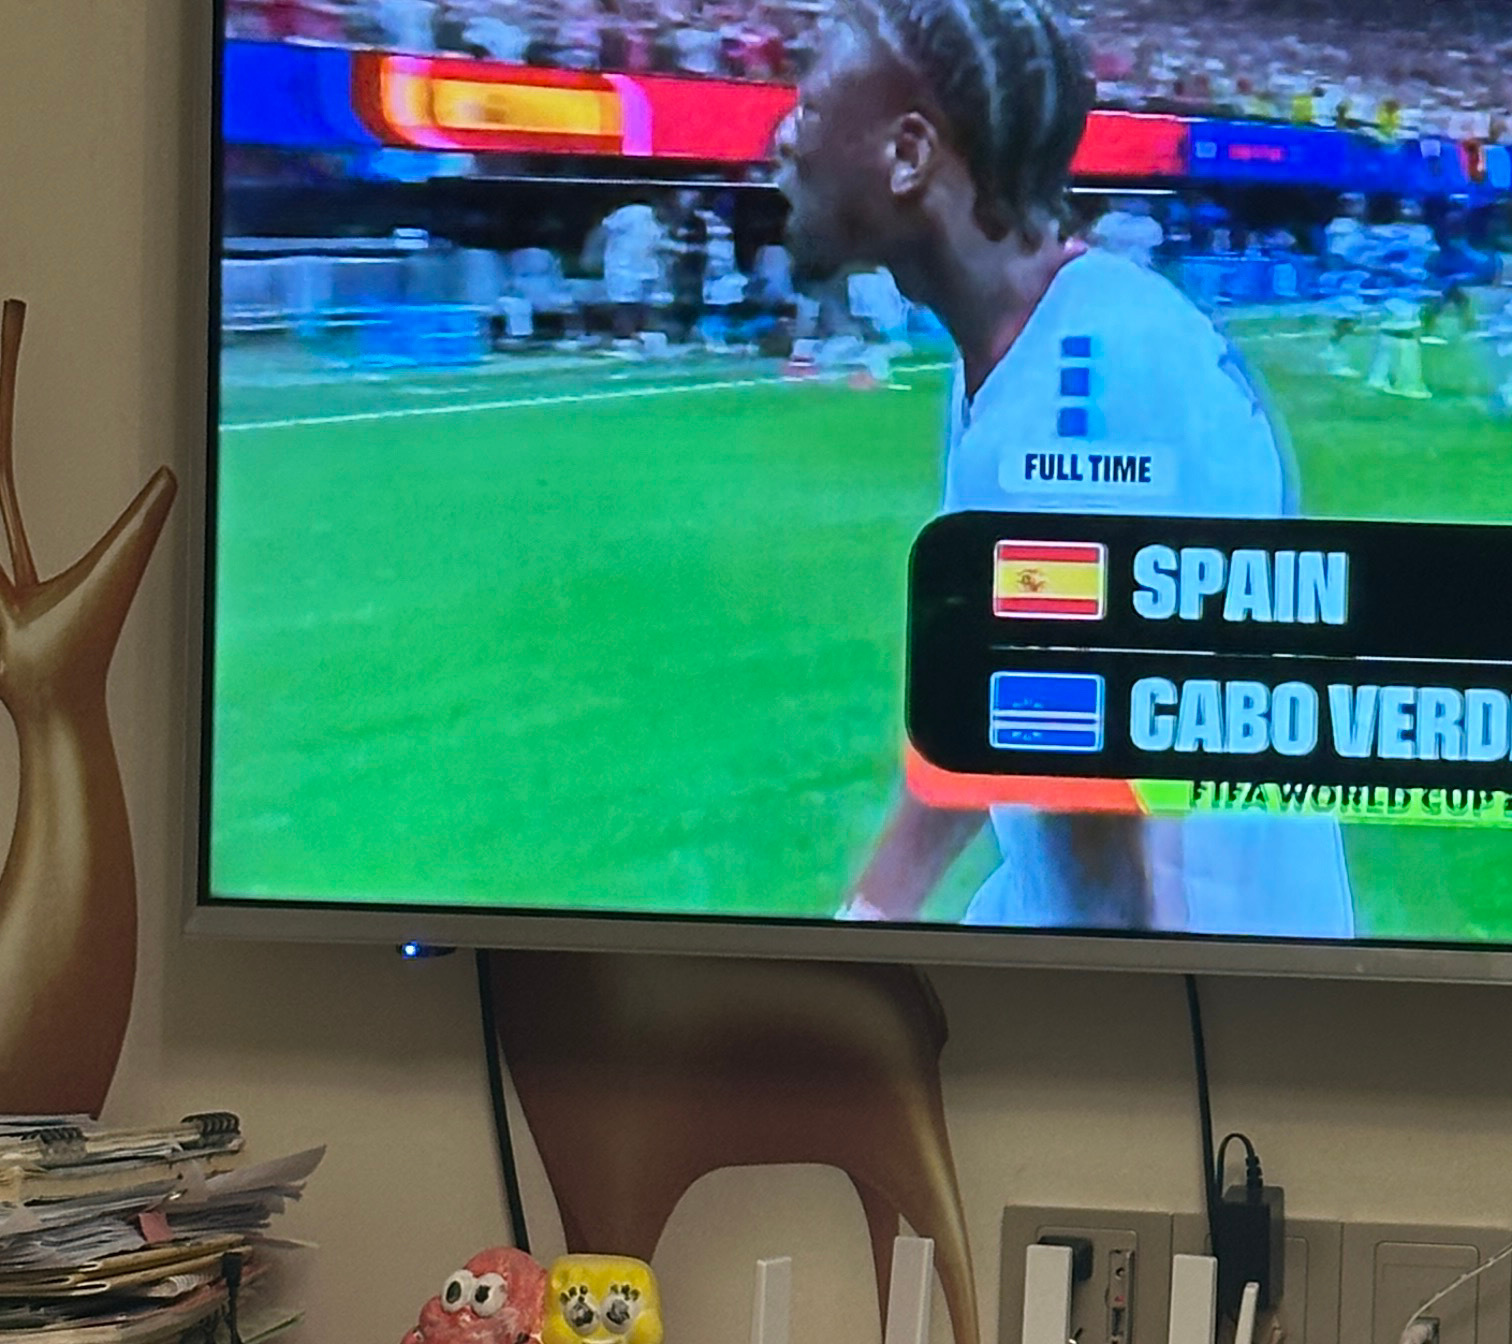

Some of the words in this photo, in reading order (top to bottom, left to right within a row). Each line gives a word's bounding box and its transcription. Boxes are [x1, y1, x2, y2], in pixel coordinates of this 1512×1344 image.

[1023, 454, 1083, 482] FULL
[1086, 455, 1153, 484] TIME
[1131, 542, 1350, 625] SPAIN
[1129, 676, 1315, 758] CABO
[1190, 782, 1267, 808] FIFA
[1277, 784, 1411, 812] WORLD
[1422, 789, 1496, 816] CUP
